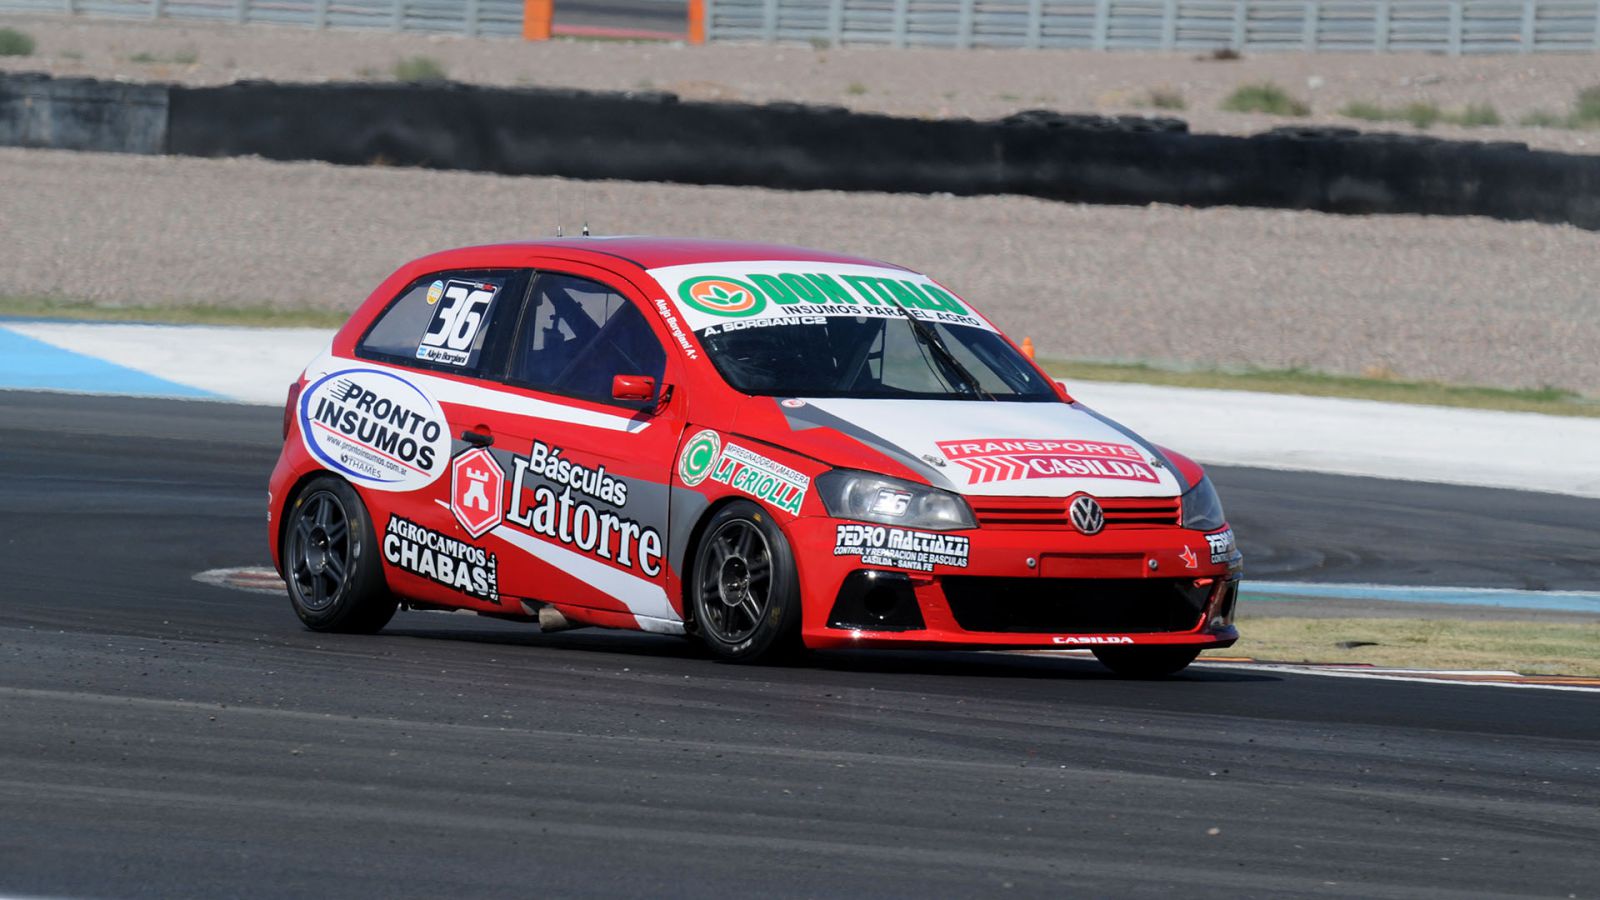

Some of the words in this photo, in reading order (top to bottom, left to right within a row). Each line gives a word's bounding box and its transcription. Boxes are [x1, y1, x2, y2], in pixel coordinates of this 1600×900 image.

[744, 272, 852, 305] DON
[838, 275, 969, 316] ITALO
[423, 286, 493, 350] 36
[655, 299, 671, 318] Alejo
[781, 305, 861, 315] INSUMOS
[863, 306, 906, 316] PARA
[911, 310, 933, 319] EL
[936, 312, 980, 326] AGRO
[704, 328, 721, 337] A.
[722, 317, 800, 332] BORGIANI
[801, 316, 828, 325] C2
[327, 378, 441, 443] PRONTO
[314, 397, 435, 470] INSUMOS
[942, 441, 1141, 458] TRANSPORTE
[348, 457, 382, 478] THAMES
[530, 441, 627, 507] Básculas
[1028, 457, 1152, 479] CASILDA
[712, 457, 735, 482] LA
[732, 466, 803, 515] CRIOLLA
[507, 457, 662, 576] Latorre
[387, 516, 487, 567] AGROCAMPOS
[836, 525, 886, 548] PEDRO
[384, 534, 489, 595] CHABAS
[834, 546, 865, 555] CONTROL
[870, 549, 917, 561] REPARACION
[918, 553, 928, 562] DE
[929, 554, 968, 567] BASCULAS
[862, 555, 893, 566] CASILDA
[898, 561, 922, 571] SANTA
[923, 563, 933, 571] FE
[1052, 636, 1134, 644] CASILDA
